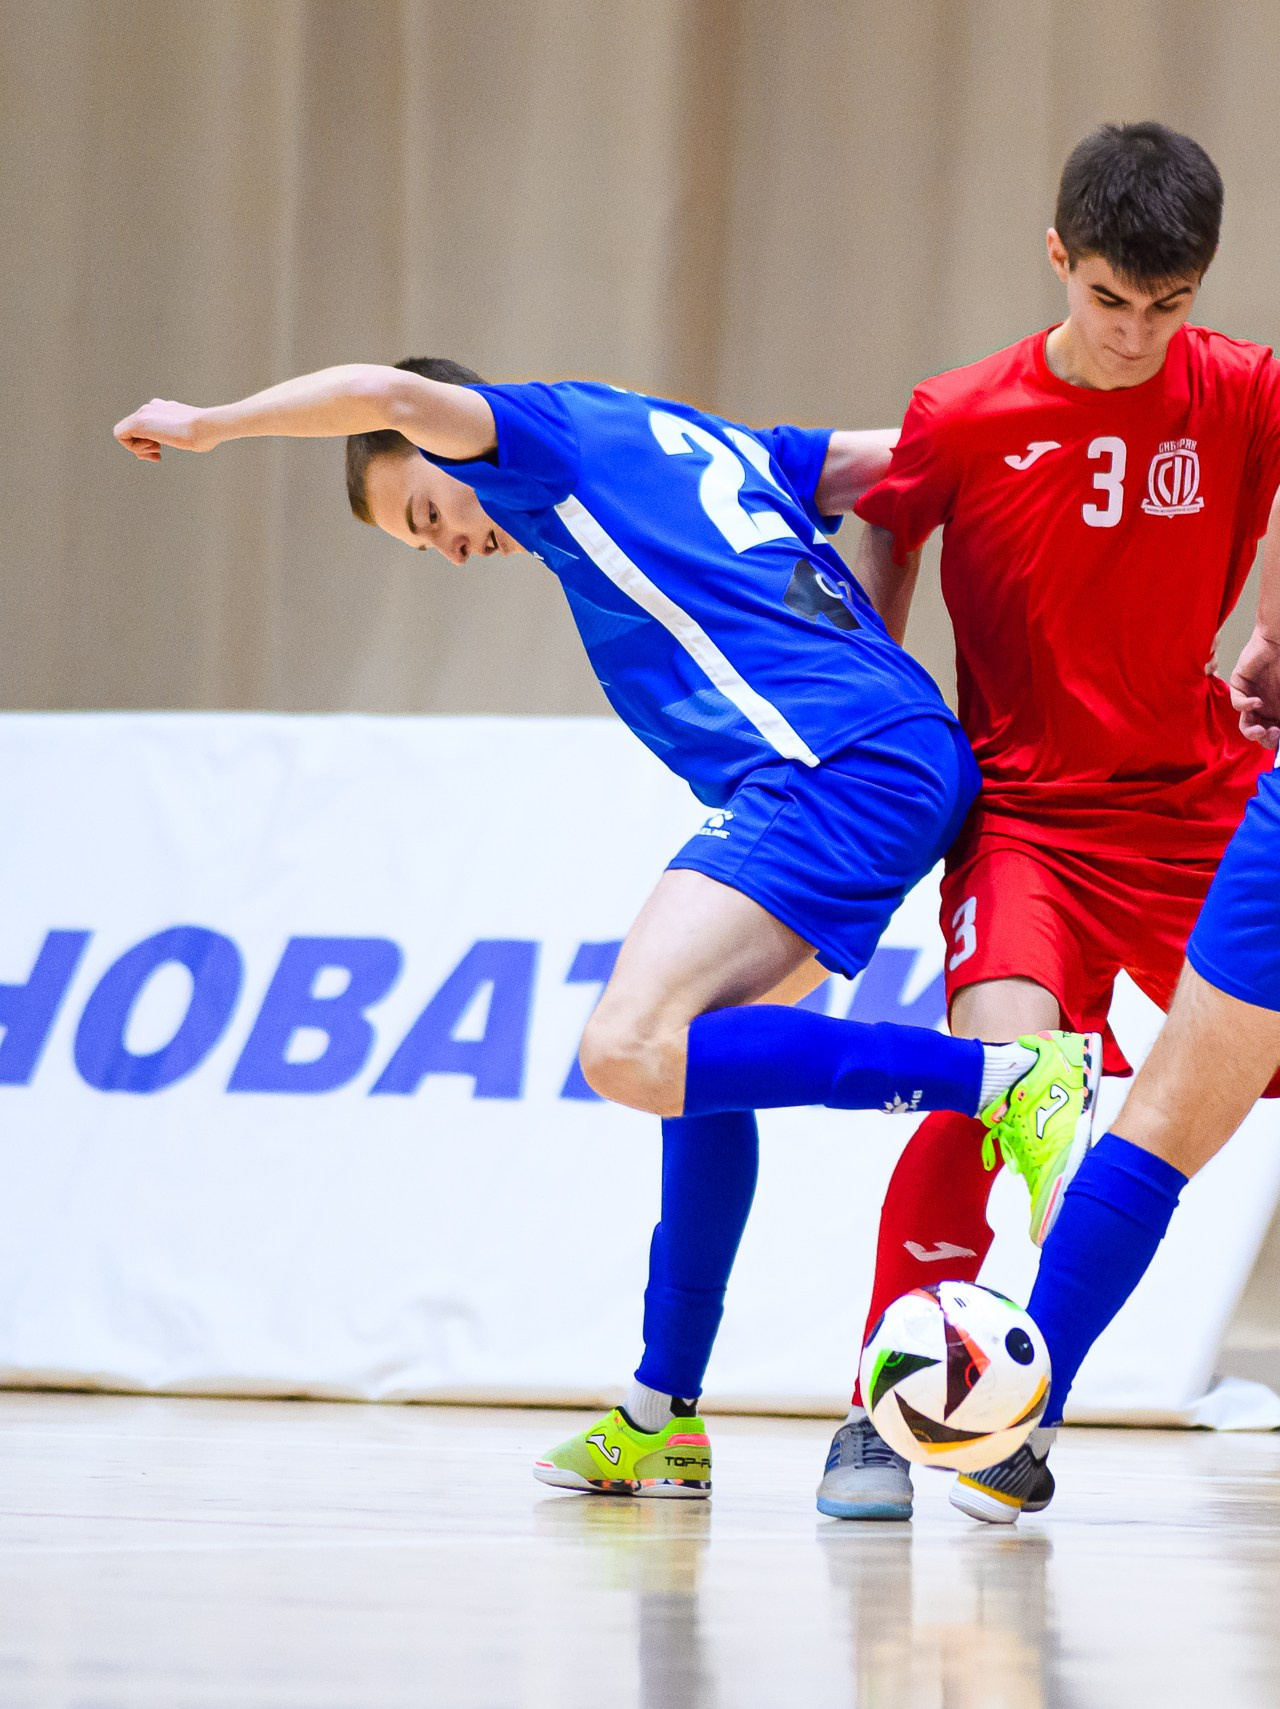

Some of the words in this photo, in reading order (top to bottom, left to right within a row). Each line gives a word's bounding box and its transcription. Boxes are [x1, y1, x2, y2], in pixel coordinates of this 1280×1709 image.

[1082, 435, 1127, 528] 3
[949, 896, 977, 972] 3
[0, 923, 948, 1102] НОВА
